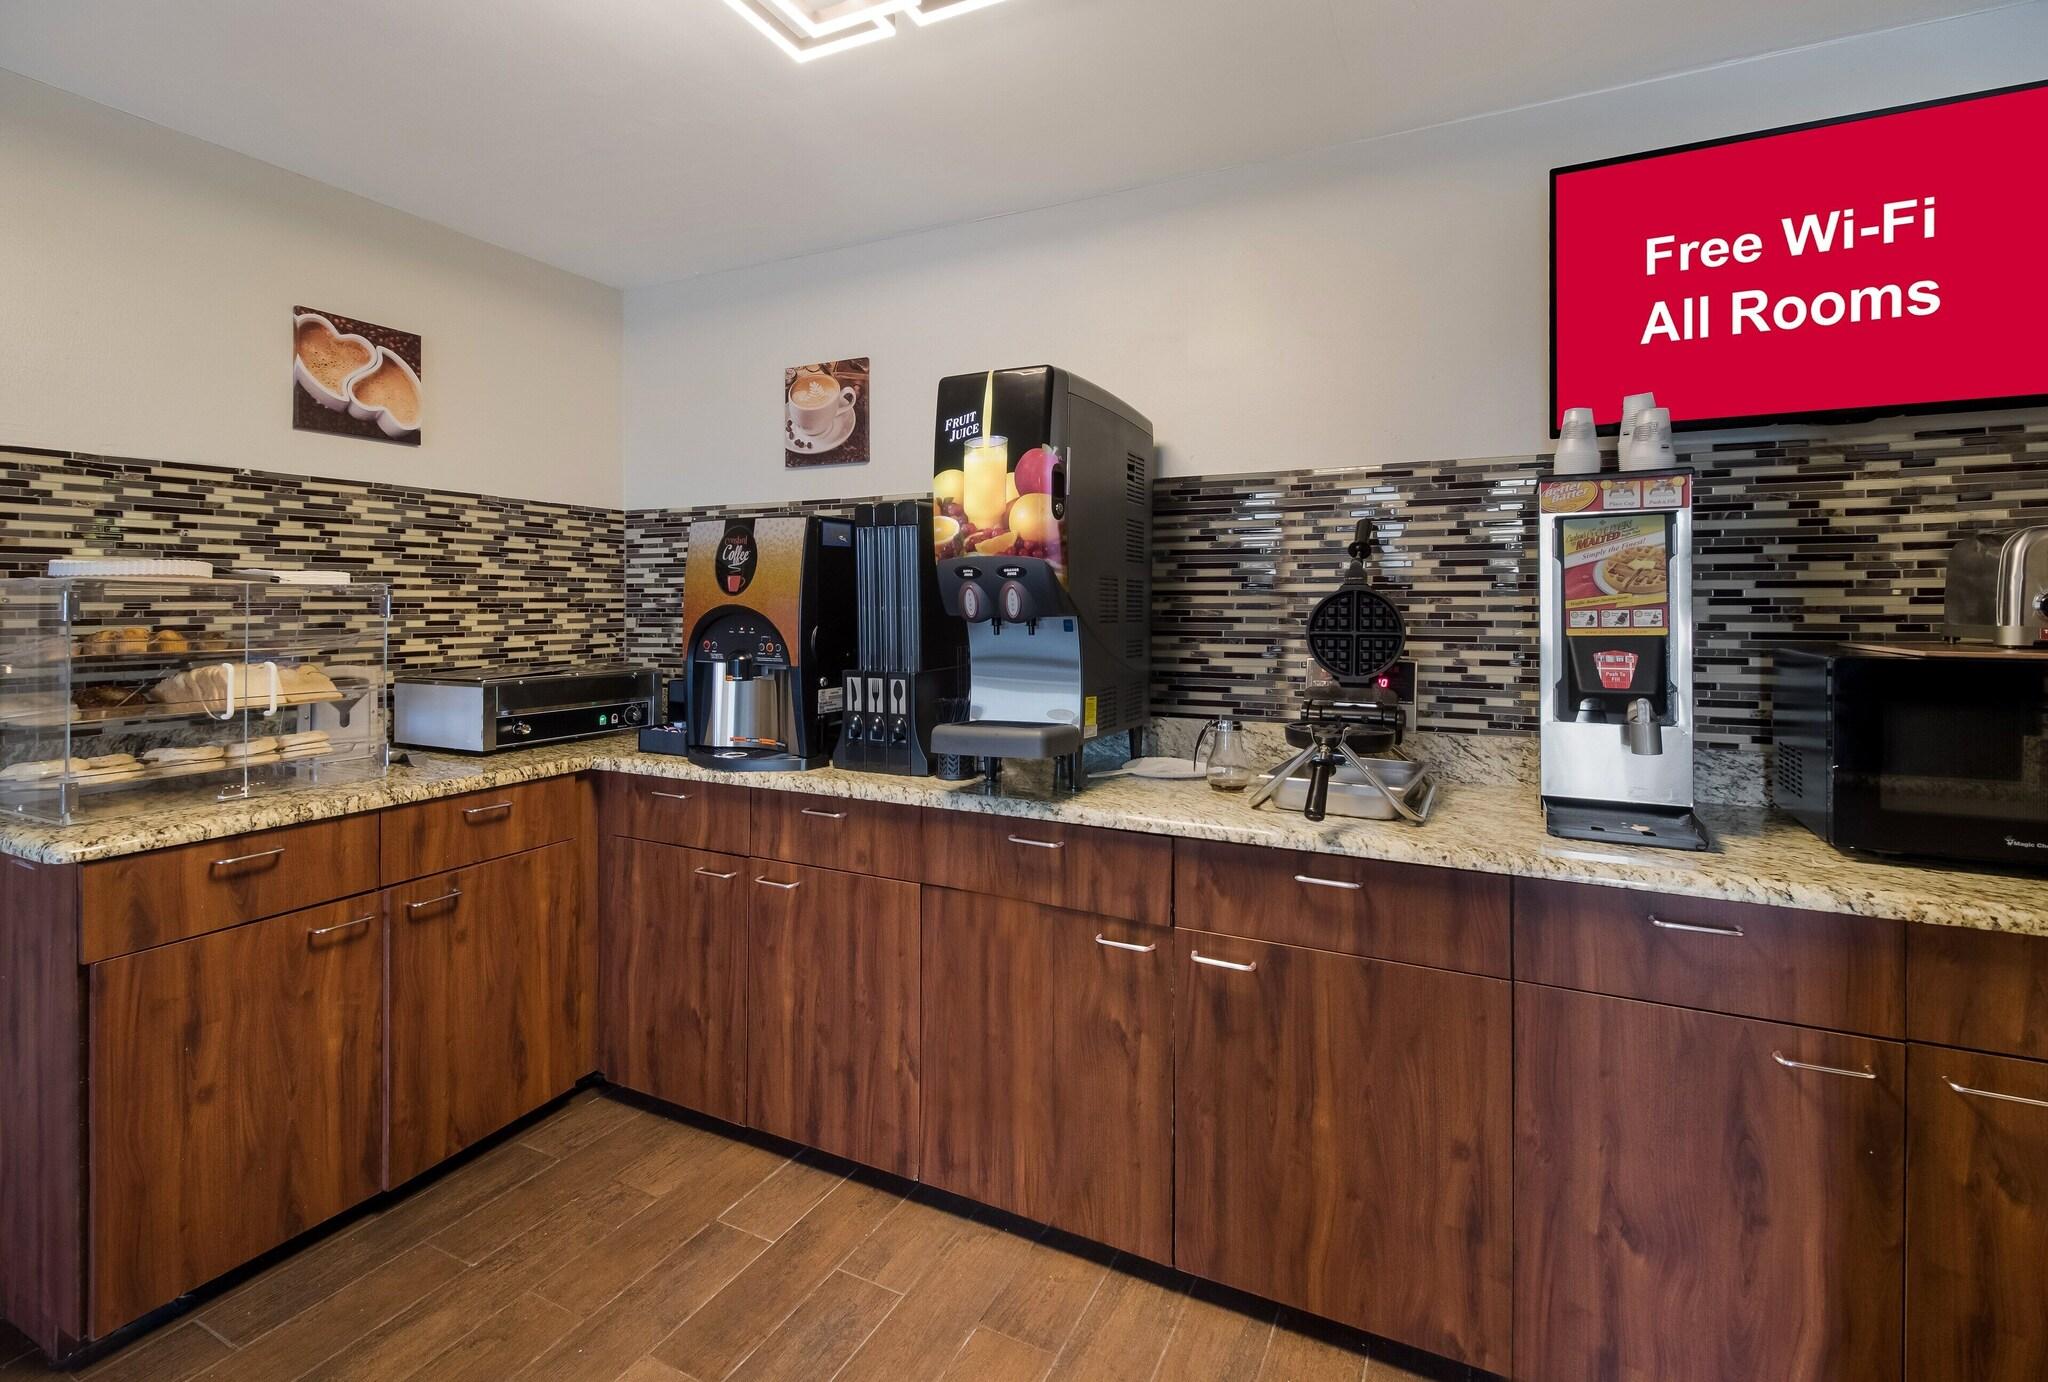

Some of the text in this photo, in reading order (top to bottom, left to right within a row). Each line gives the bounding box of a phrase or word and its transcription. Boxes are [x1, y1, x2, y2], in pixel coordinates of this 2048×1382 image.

[1646, 196, 1936, 276] Free Wi-Fi
[1640, 280, 1942, 344] All Rooms
[945, 410, 977, 431] FRUIT
[949, 422, 980, 442] JUICE
[722, 543, 752, 565] Coffee
